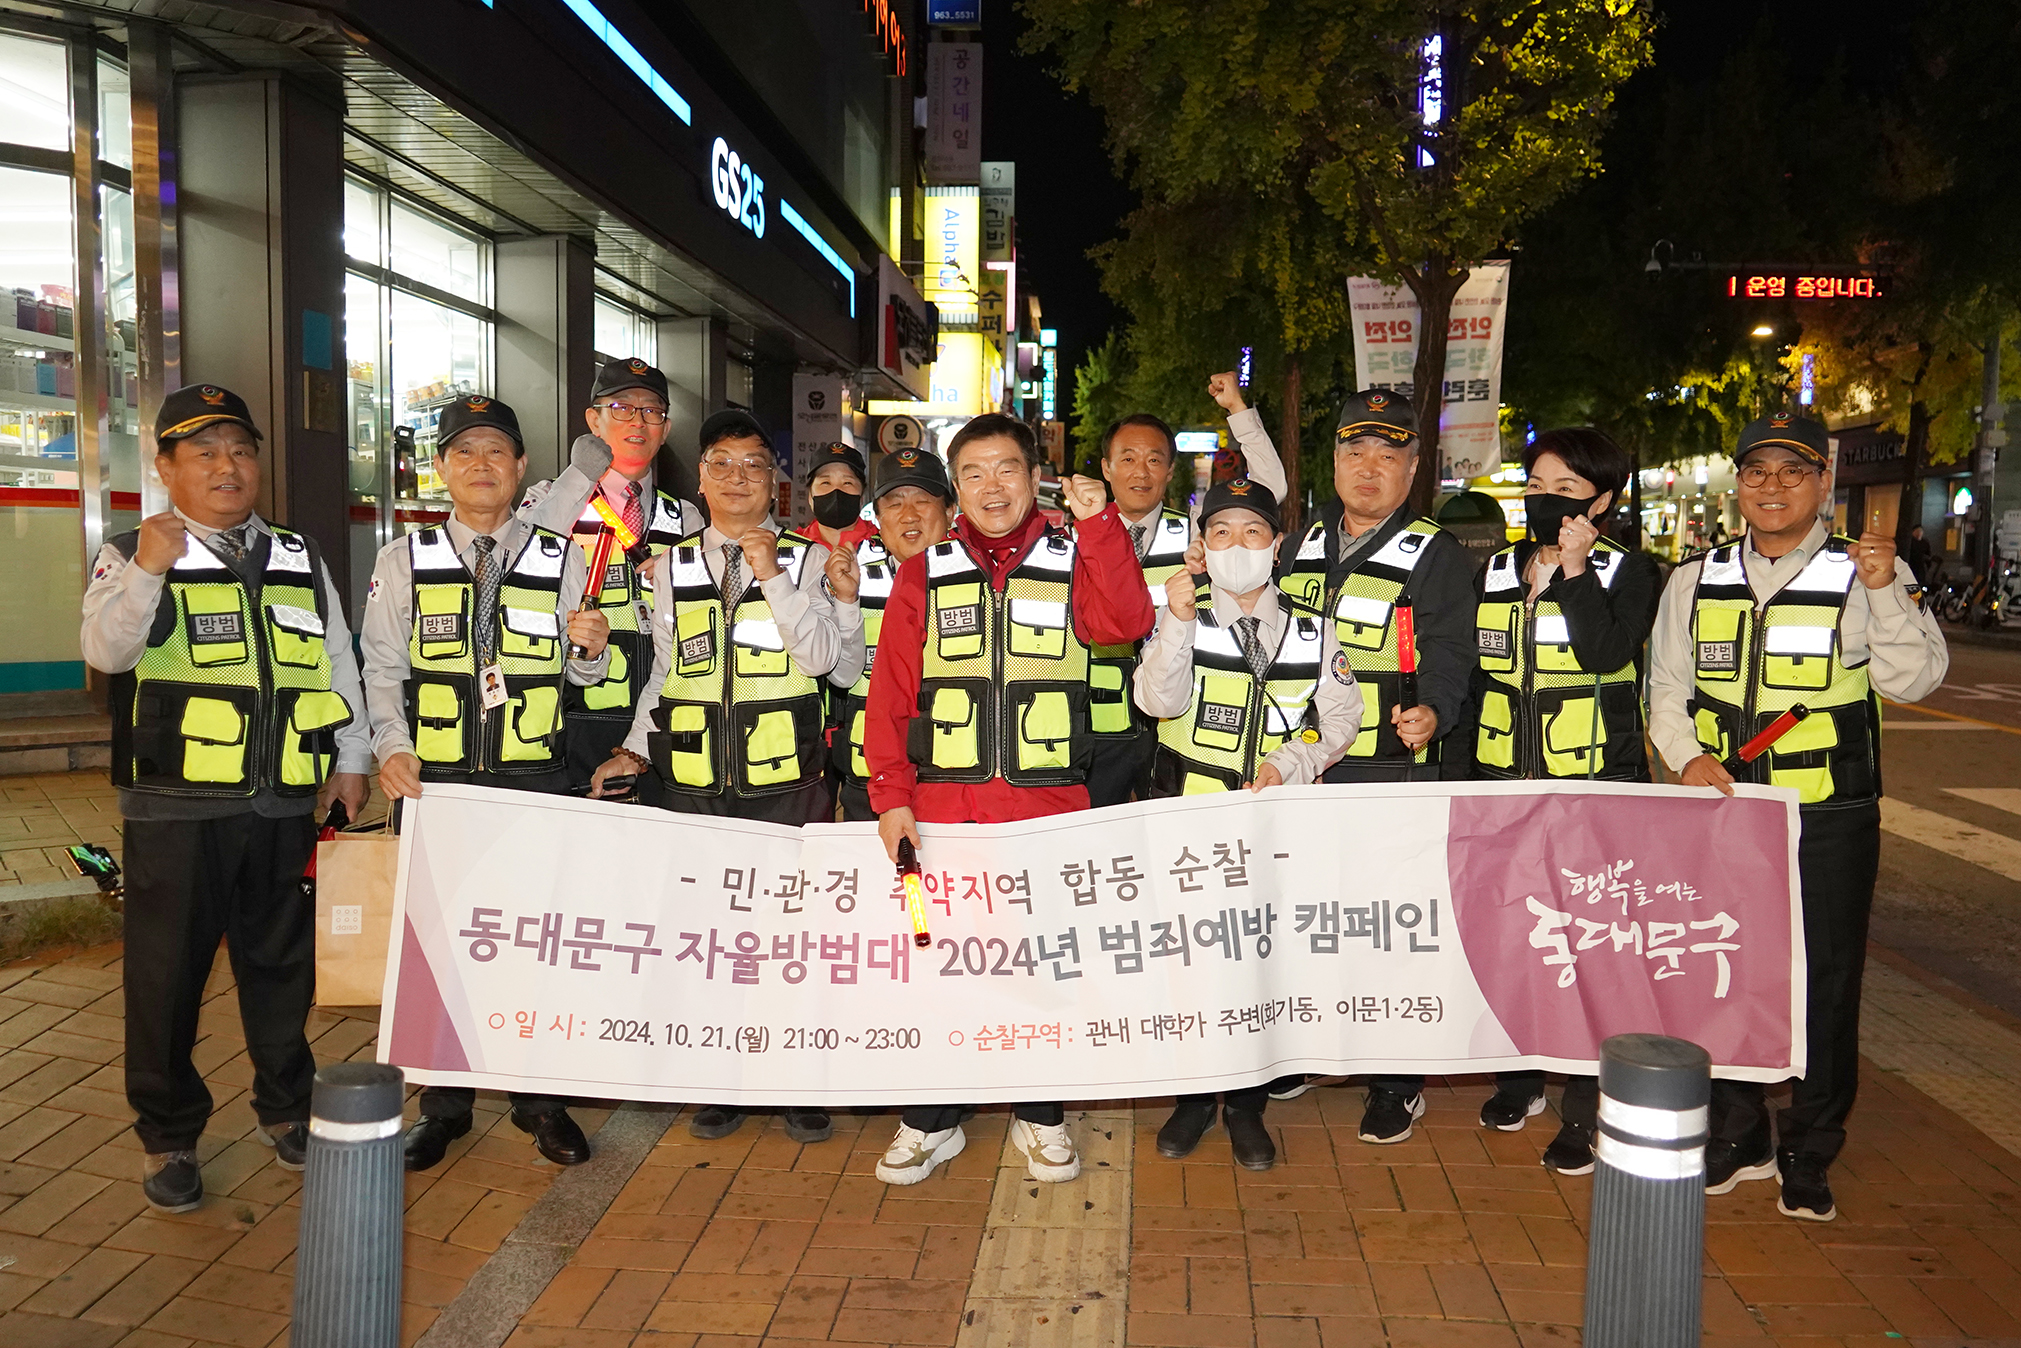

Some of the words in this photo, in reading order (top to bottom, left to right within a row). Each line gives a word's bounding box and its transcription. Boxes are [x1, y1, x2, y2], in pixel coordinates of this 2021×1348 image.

[711, 136, 765, 239] GS25
[1747, 276, 1785, 297] 운영
[1796, 276, 1882, 297] 중입니다.
[199, 616, 235, 633] 방범
[426, 617, 454, 633] 방범
[944, 609, 973, 626] 방범
[684, 636, 708, 656] 방범
[1481, 632, 1503, 646] 방범
[1704, 644, 1730, 660] 방범
[1208, 706, 1238, 722] 방범
[1202, 722, 1221, 730] CITIZENS
[723, 867, 859, 914] 민·관·경
[1061, 855, 1144, 907] 합동
[1170, 839, 1251, 892] 순찰
[1561, 859, 1654, 916] 행복을
[1655, 880, 1702, 902] 여는
[459, 907, 662, 974] 동대문구
[675, 928, 910, 984] 자율방범대
[938, 929, 1083, 980] 2024년
[1099, 902, 1278, 975] 범죄예방
[1294, 899, 1440, 954] 캠페인
[1526, 895, 1741, 998] 동대문구
[598, 1018, 655, 1046] 2024.
[664, 1023, 693, 1048] 10.
[1085, 1014, 1130, 1047] 관내
[1141, 1010, 1207, 1042] 대학가
